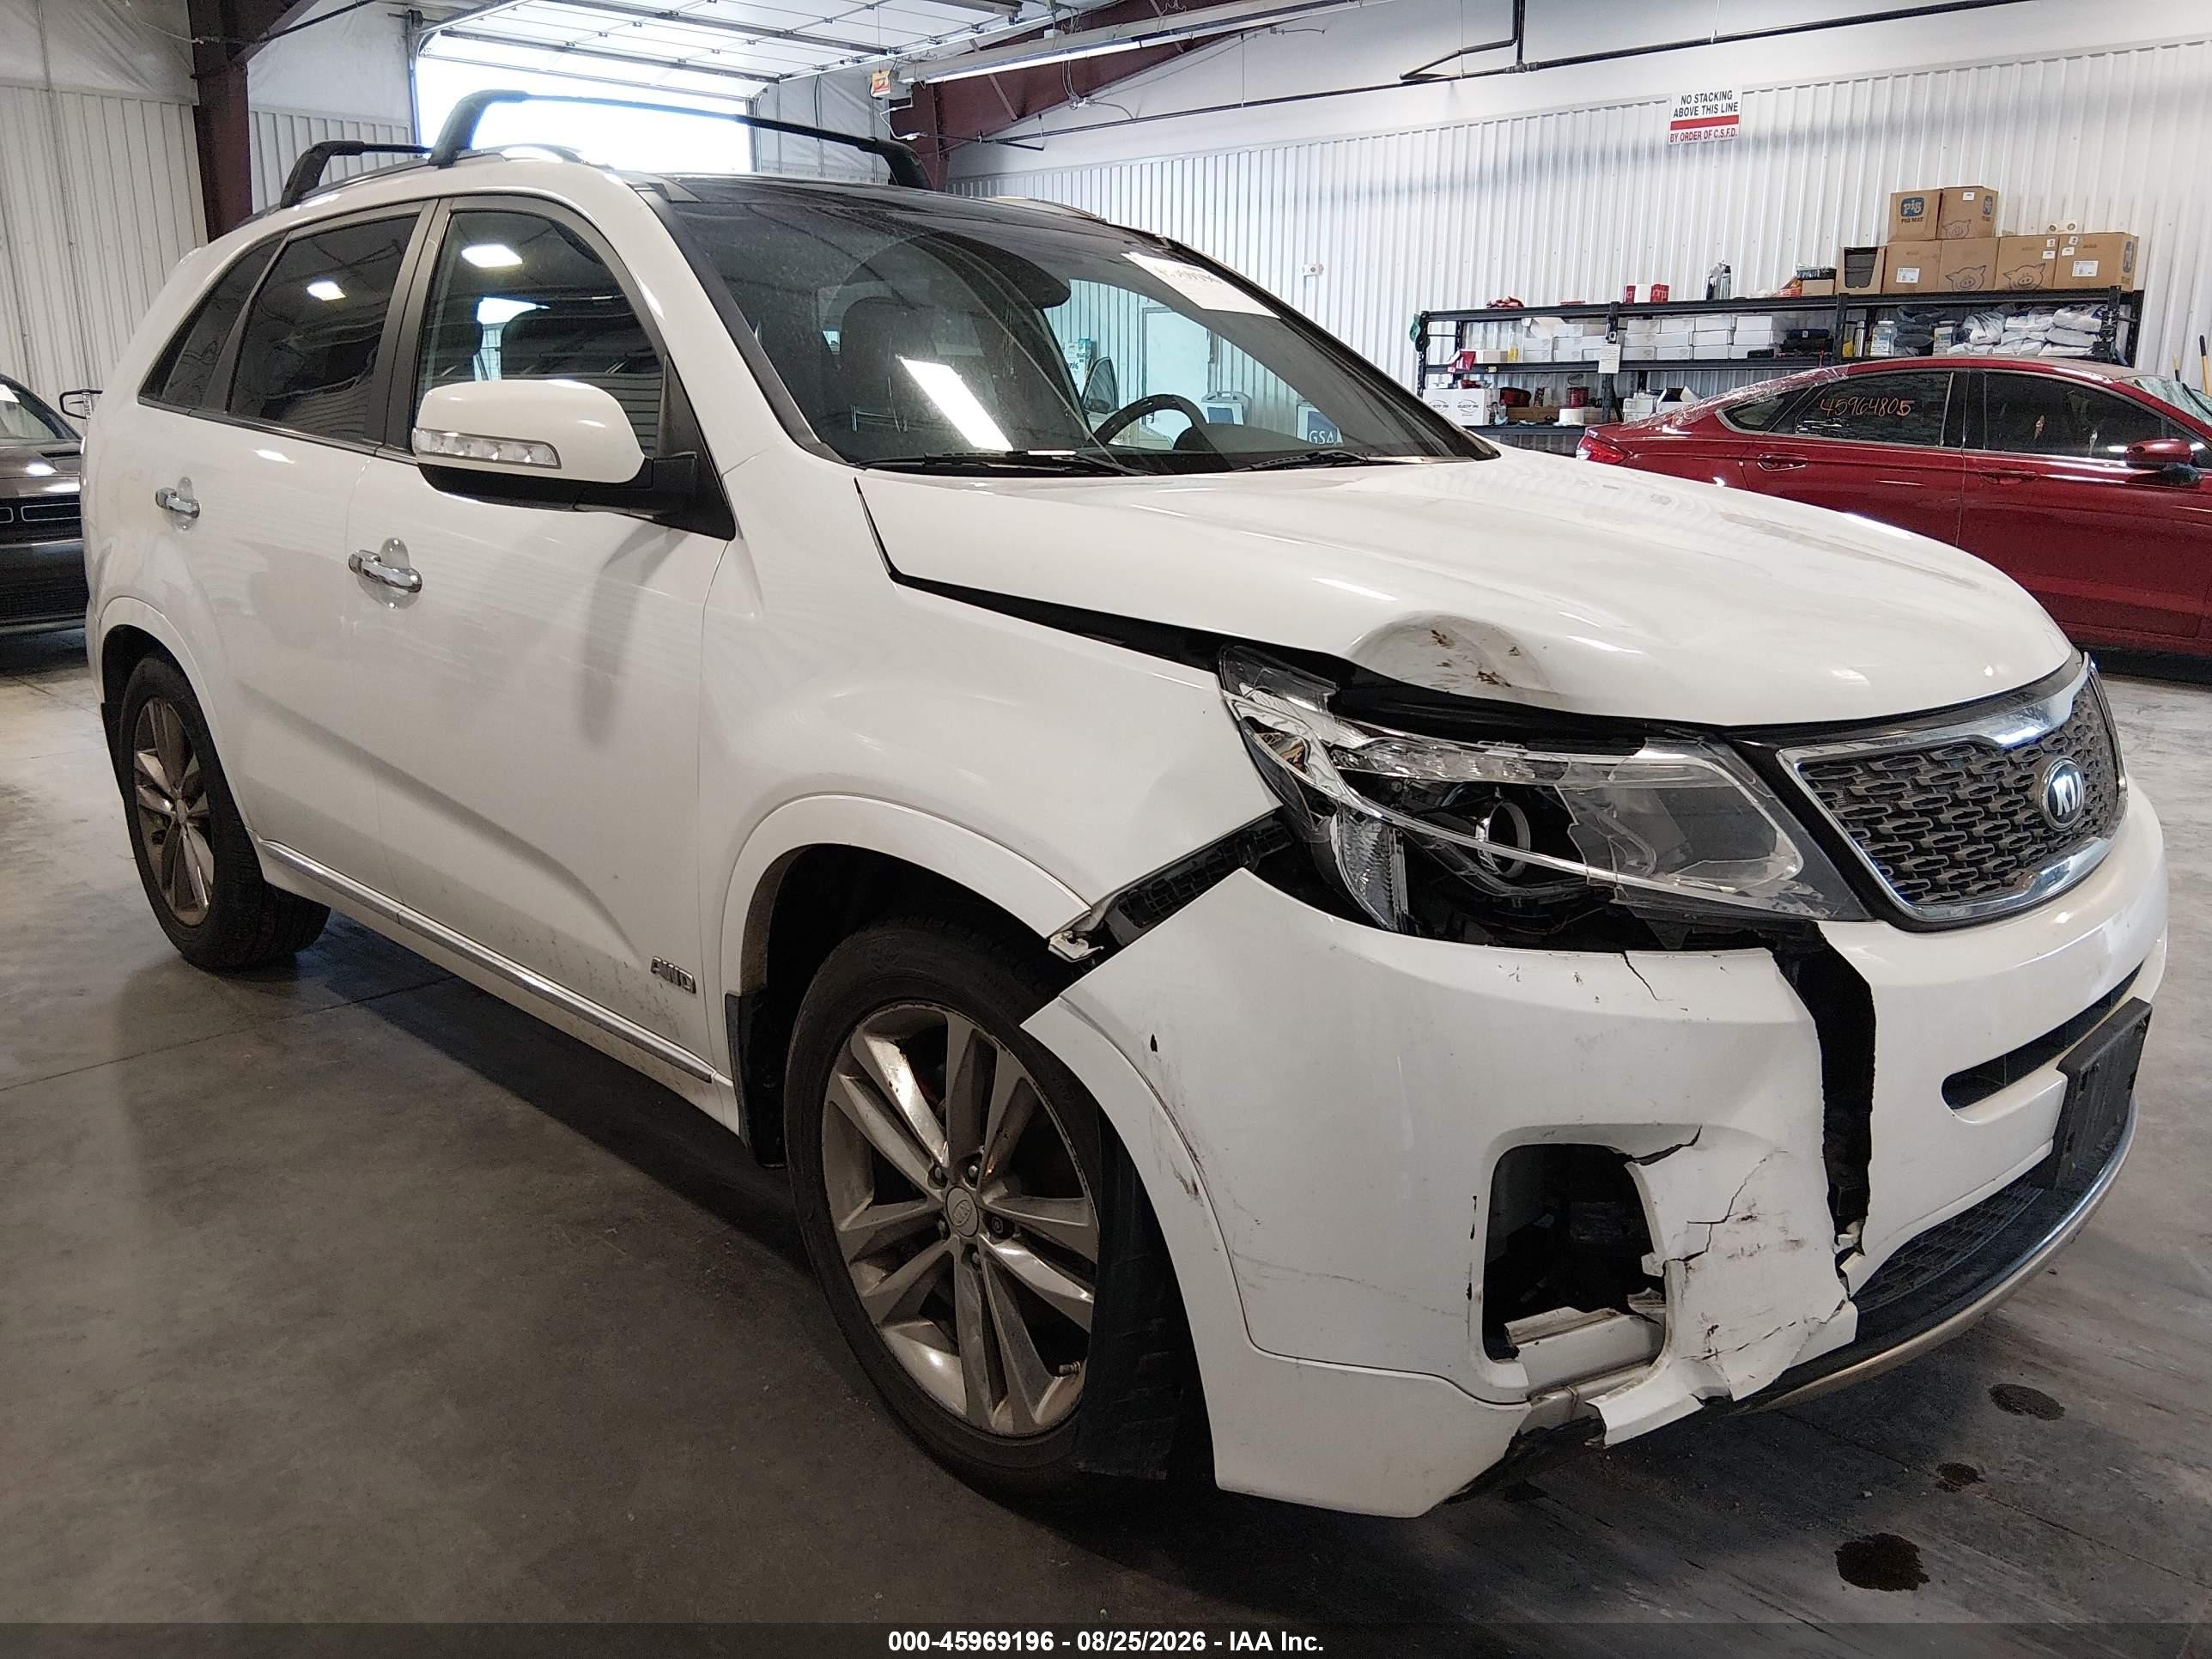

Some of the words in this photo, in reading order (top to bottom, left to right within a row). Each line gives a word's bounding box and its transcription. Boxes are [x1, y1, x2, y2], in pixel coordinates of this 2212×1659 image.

[1680, 94, 1692, 105] NO
[1694, 90, 1733, 104] STACKING
[1674, 106, 1699, 118] ABOVE
[1702, 104, 1719, 115] THIS
[1721, 101, 1739, 113] LINE
[1670, 133, 1680, 143] BY
[1680, 131, 1702, 142] ORDER
[1704, 129, 1713, 139] OF
[1820, 397, 1915, 416] 45964805
[1309, 429, 1334, 445] GSA
